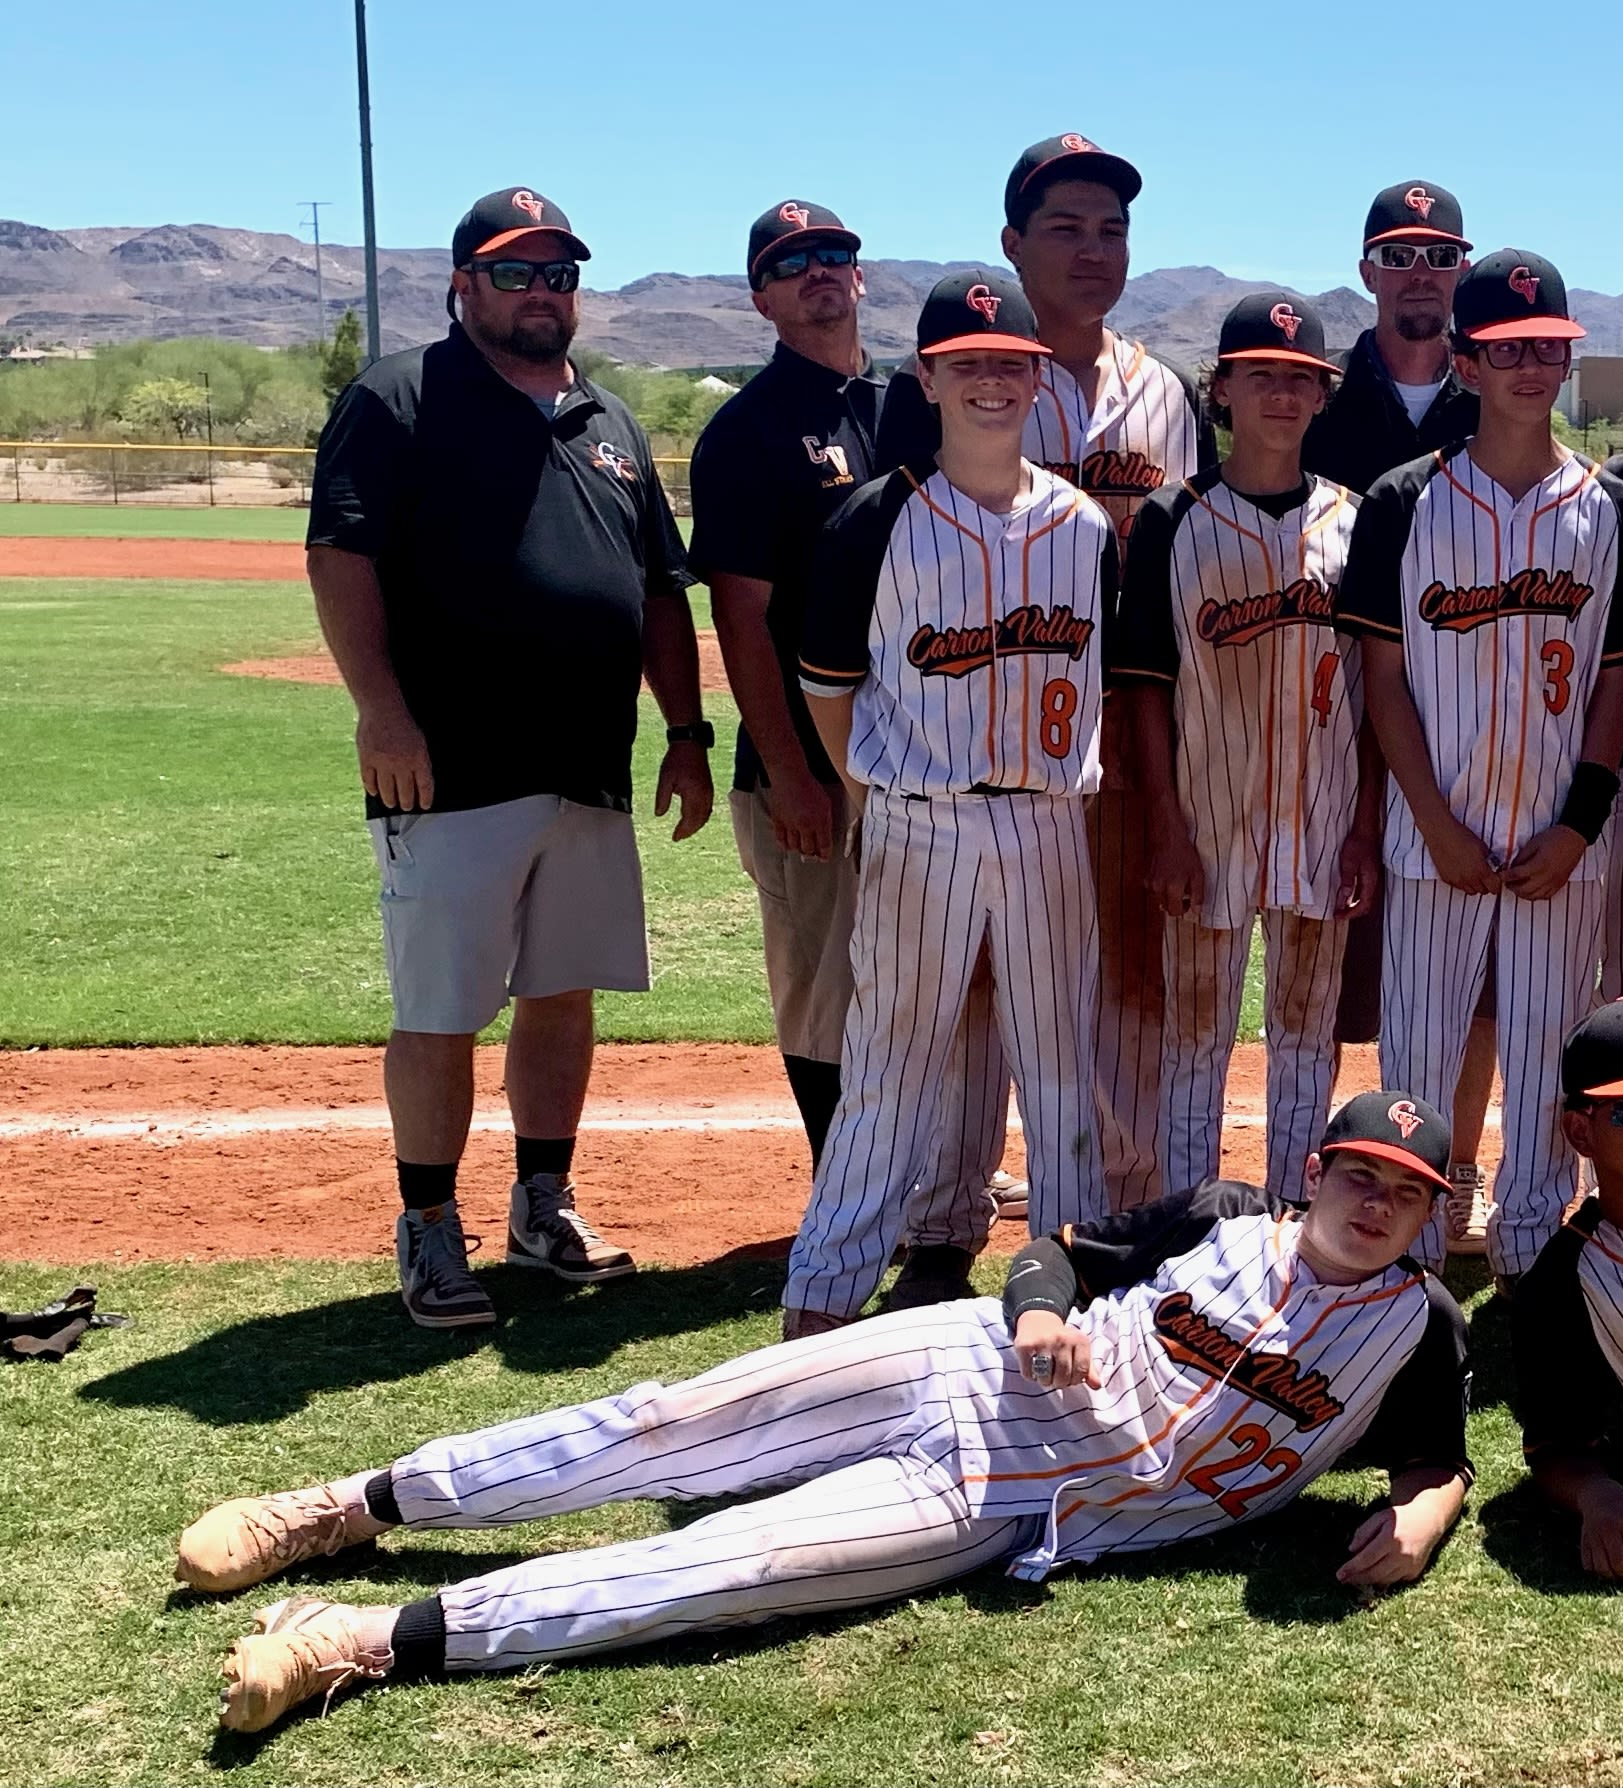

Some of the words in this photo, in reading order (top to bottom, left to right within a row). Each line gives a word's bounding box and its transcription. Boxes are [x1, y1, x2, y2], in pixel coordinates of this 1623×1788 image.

[1083, 450, 1165, 489] Valley
[1197, 591, 1284, 641] Carson
[1419, 581, 1506, 623] Carson
[1509, 568, 1594, 623] Valley
[907, 622, 1001, 668] Carson
[1003, 605, 1095, 661] Valley
[1311, 651, 1340, 728] 4
[1541, 639, 1575, 716] 3
[1041, 678, 1077, 759] 8
[1155, 1291, 1250, 1370] Carson
[1249, 1352, 1344, 1432] Valley
[1185, 1423, 1302, 1520] 22
